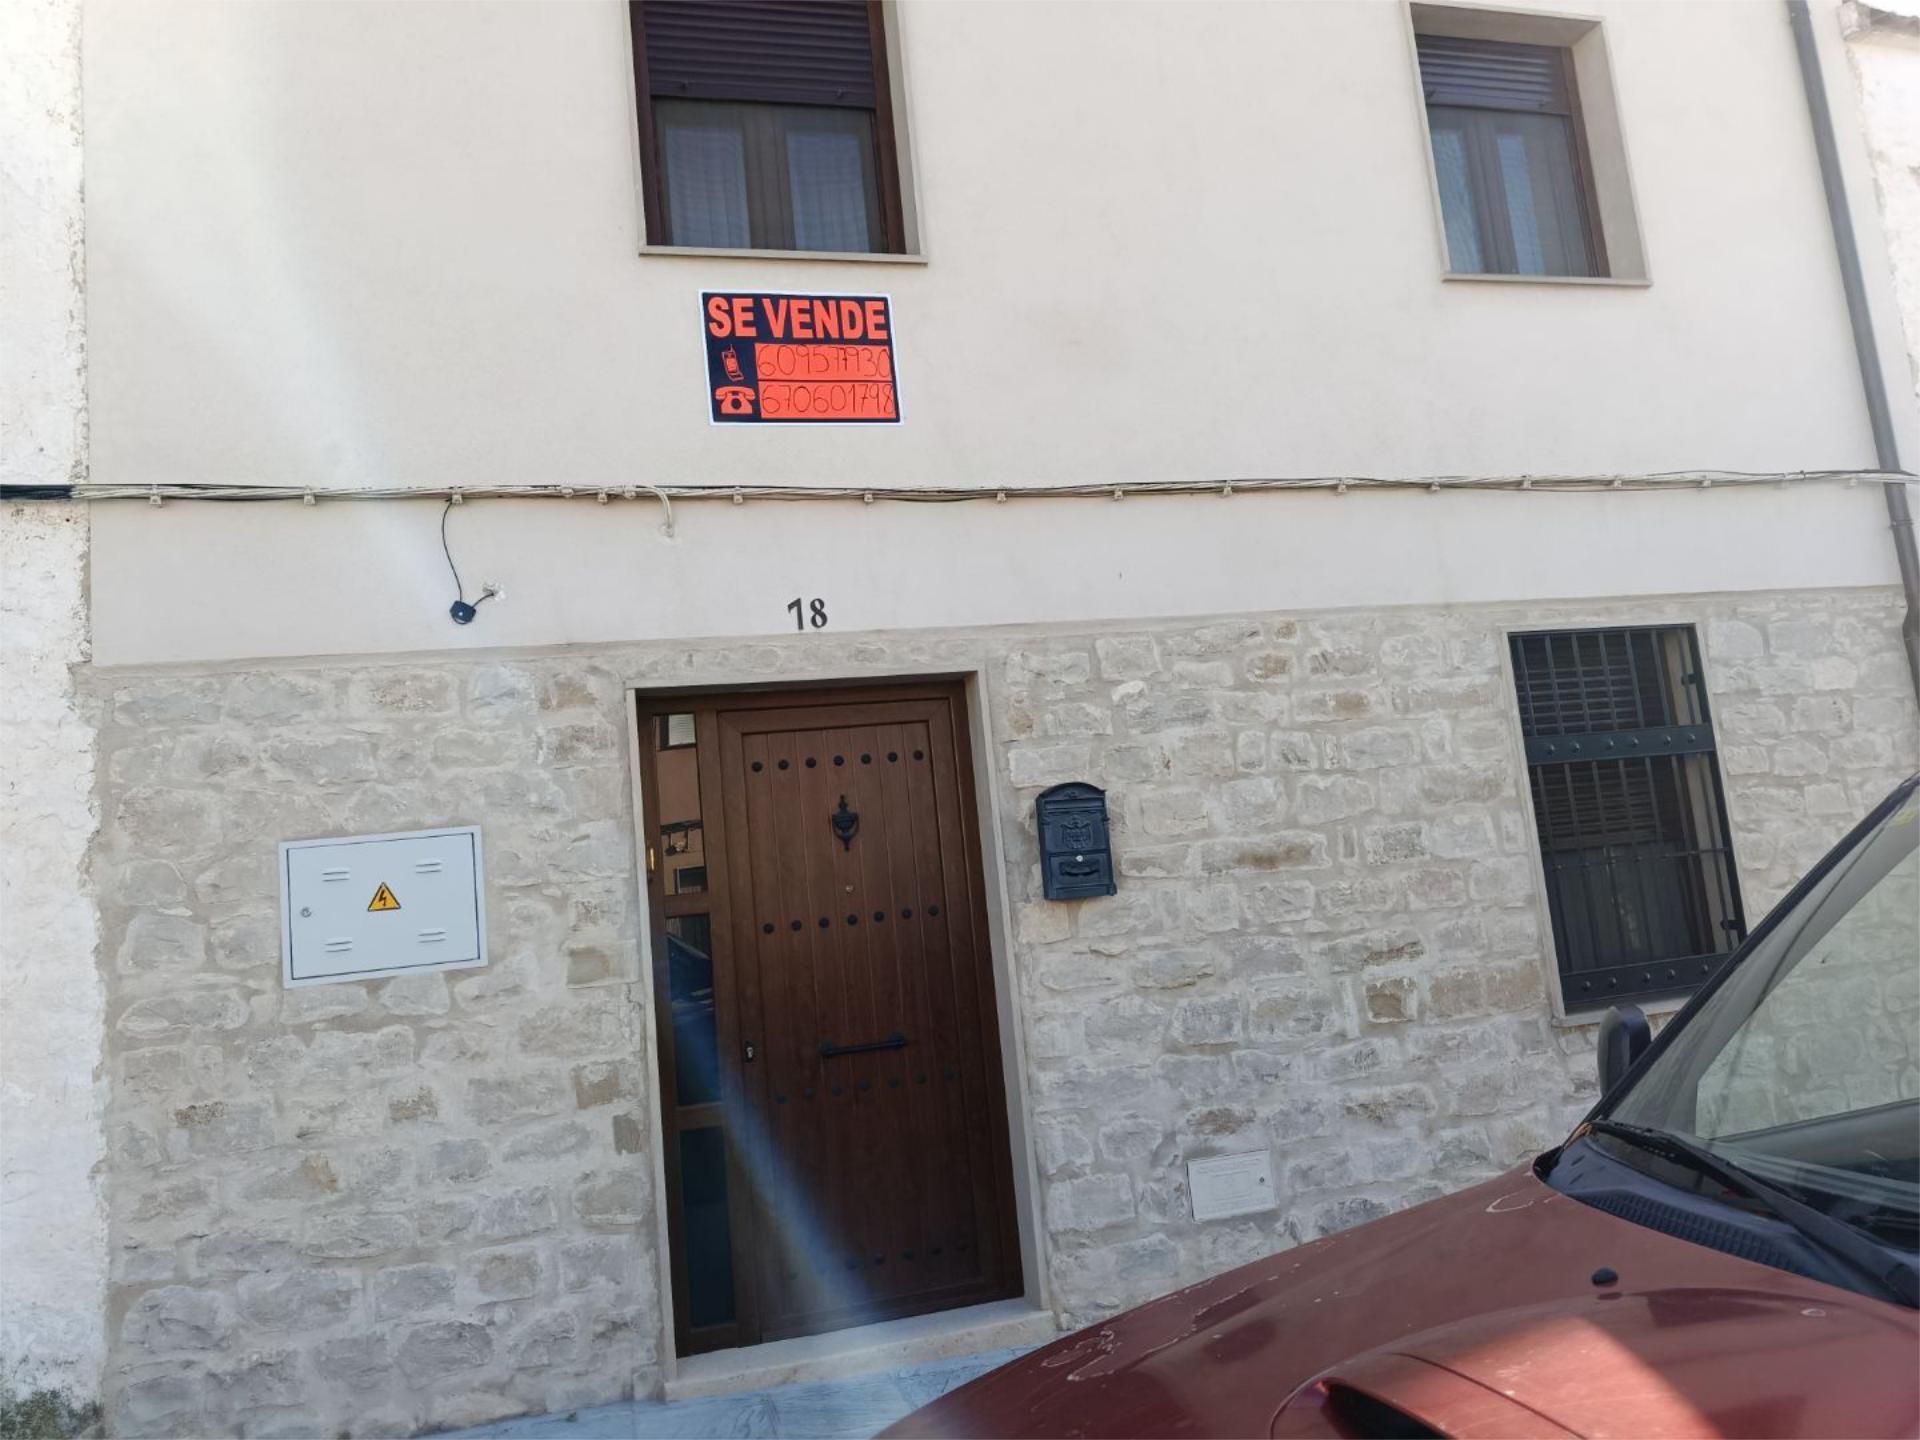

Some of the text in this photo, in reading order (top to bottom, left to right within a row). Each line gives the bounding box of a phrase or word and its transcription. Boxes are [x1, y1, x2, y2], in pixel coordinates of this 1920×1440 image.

[708, 296, 888, 339] SE VENDE
[758, 344, 891, 377] 609577930
[762, 383, 894, 415] 670601798
[787, 597, 828, 631] 18
